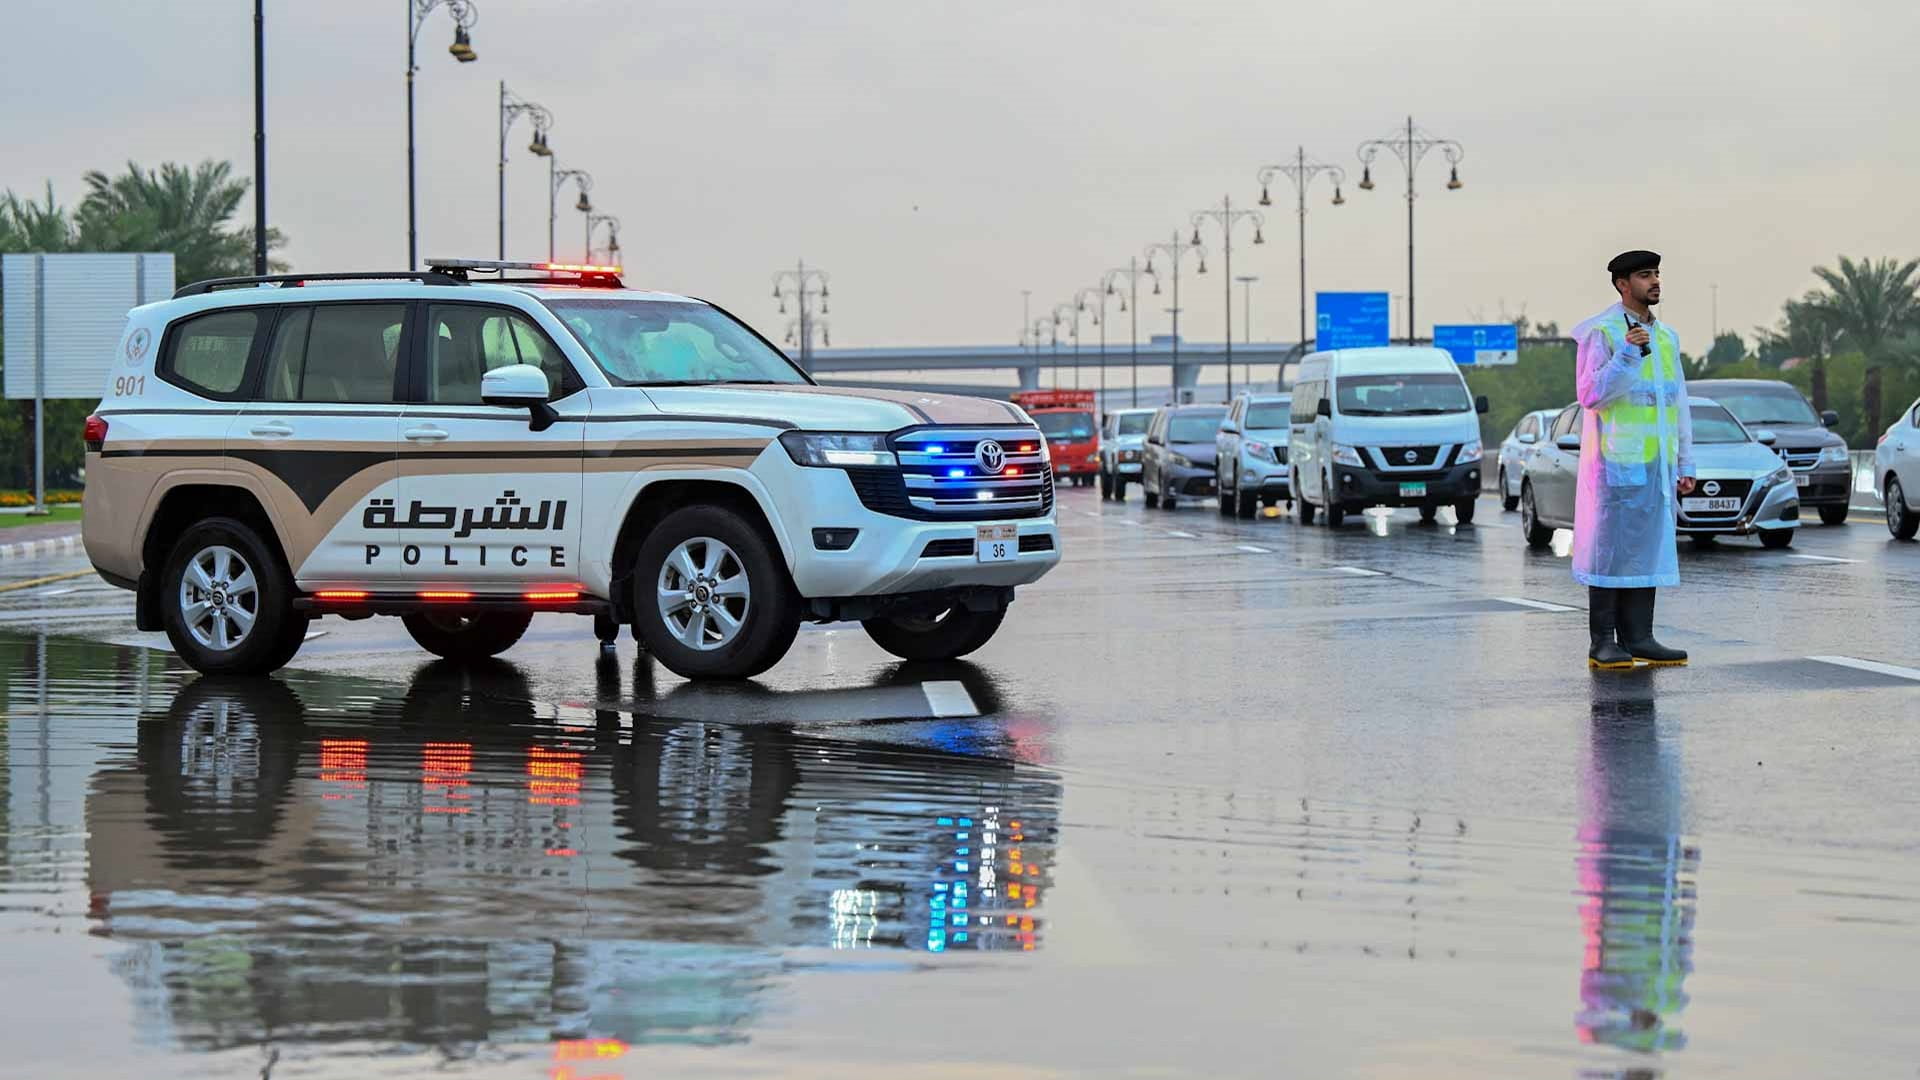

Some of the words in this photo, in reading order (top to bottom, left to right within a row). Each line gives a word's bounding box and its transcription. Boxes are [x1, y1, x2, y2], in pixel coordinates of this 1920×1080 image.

[115, 376, 145, 396] 901
[363, 490, 567, 538] الشرطة
[1708, 500, 1736, 509] 88437
[365, 544, 566, 567] POLICE
[992, 543, 1006, 558] 36
